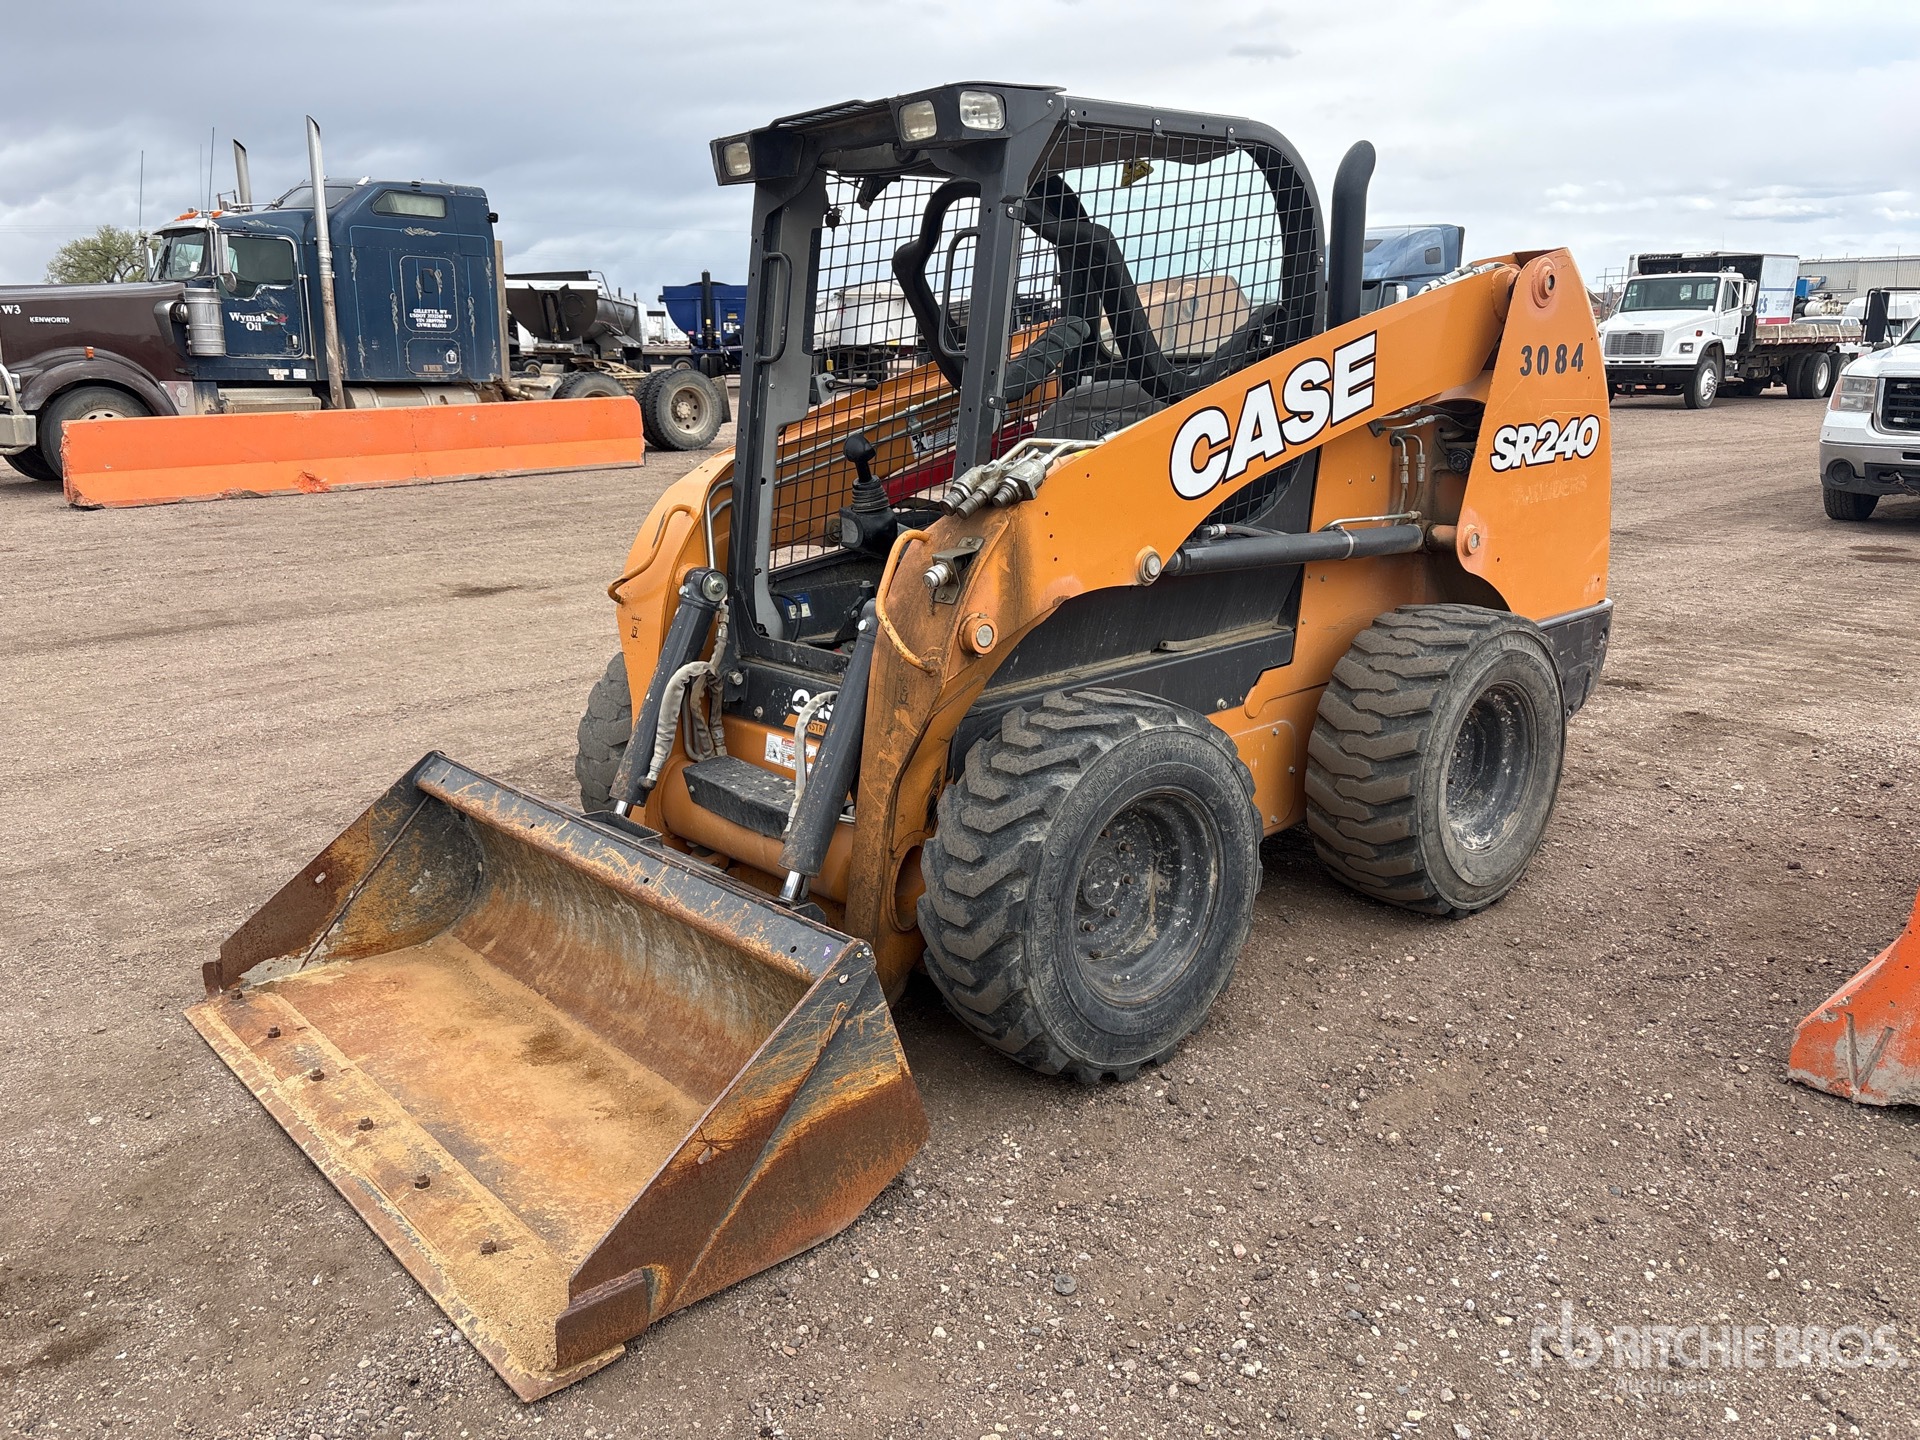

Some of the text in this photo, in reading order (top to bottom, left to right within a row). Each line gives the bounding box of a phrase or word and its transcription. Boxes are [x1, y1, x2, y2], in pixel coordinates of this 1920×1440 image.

[29, 316, 70, 324] KENWORTH
[228, 311, 268, 324] Wymak
[246, 321, 262, 331] Oil
[1520, 342, 1584, 377] 3084
[1169, 330, 1377, 500] CASE
[1490, 414, 1600, 473] SR240
